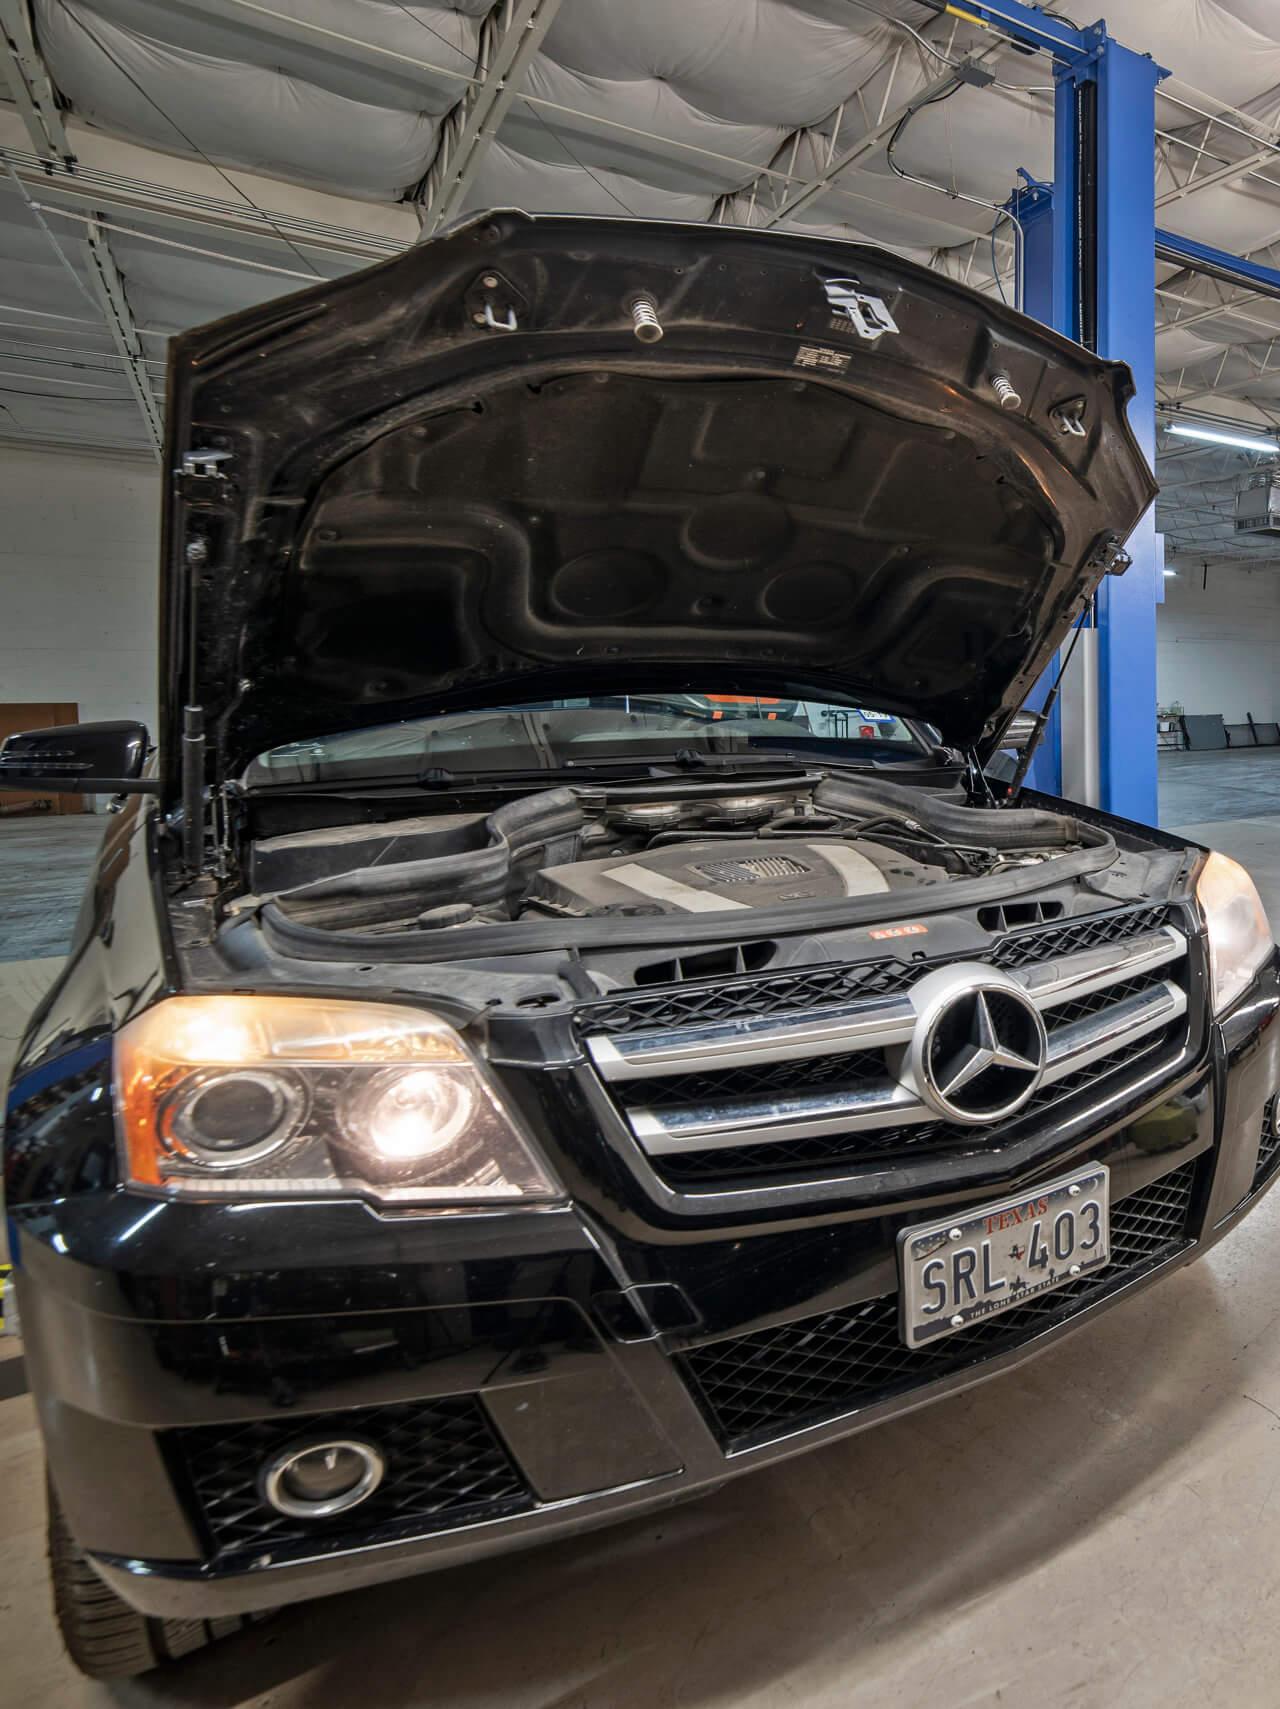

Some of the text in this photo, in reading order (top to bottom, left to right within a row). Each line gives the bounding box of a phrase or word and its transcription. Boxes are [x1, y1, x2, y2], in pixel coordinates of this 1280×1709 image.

[984, 1197, 1049, 1235] TEXAS
[921, 1200, 1100, 1315] SRL 403
[970, 1275, 1059, 1319] THE LONE STAR STATE
